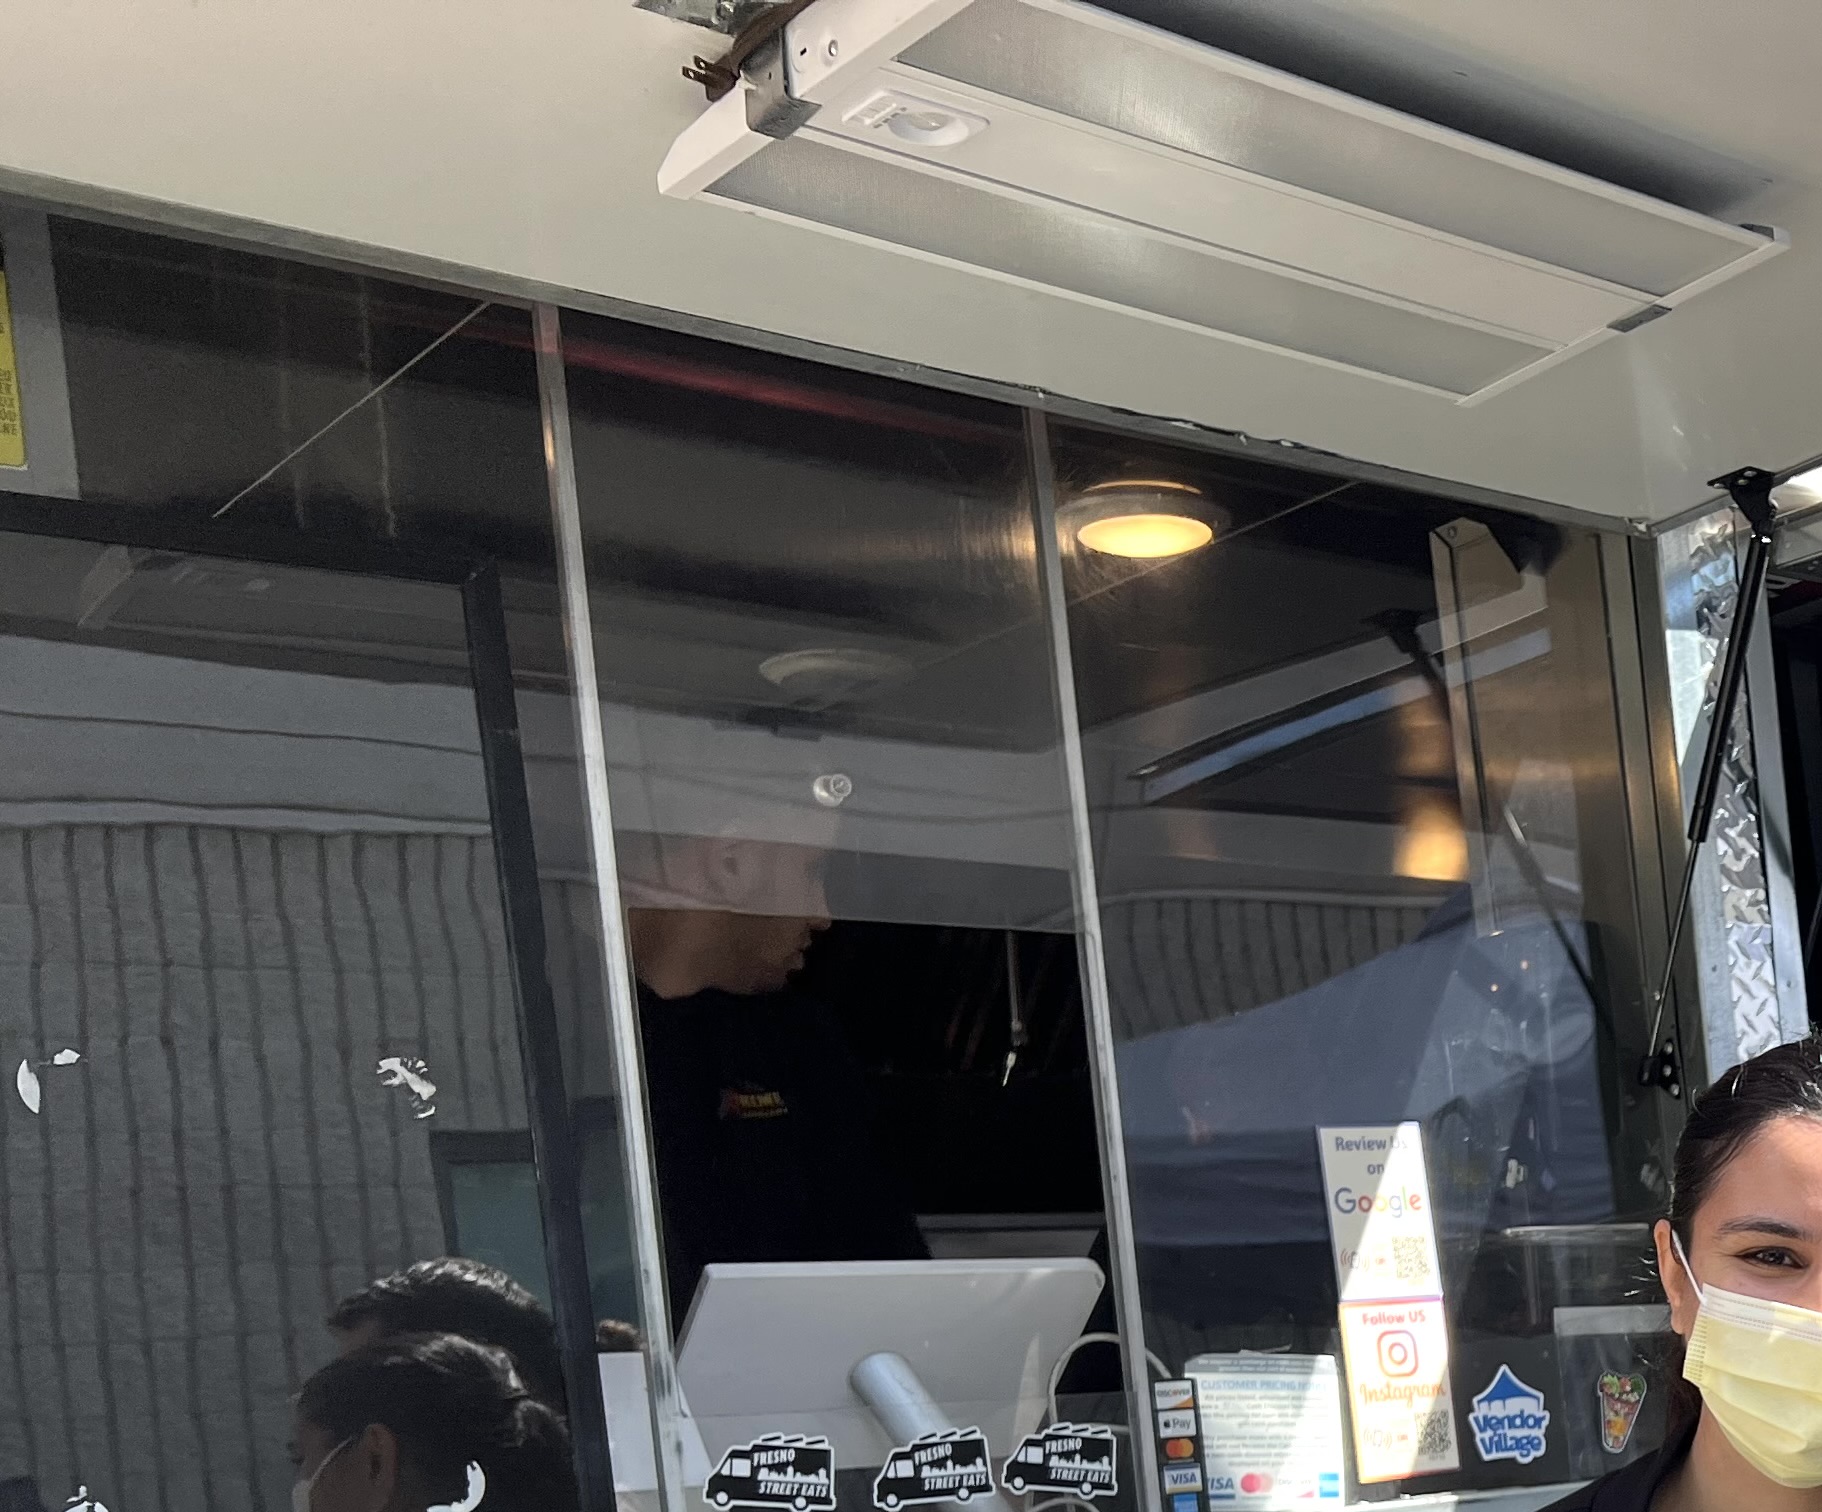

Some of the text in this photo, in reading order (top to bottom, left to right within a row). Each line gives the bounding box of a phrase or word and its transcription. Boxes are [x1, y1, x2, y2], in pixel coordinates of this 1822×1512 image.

[1335, 1136, 1387, 1151] Review
[1334, 1186, 1422, 1219] Google
[1362, 1311, 1405, 1326] Follow
[1200, 1380, 1259, 1391] CUSTOMER
[1260, 1380, 1296, 1391] PRICING
[1359, 1380, 1447, 1408] Instagram
[1172, 1418, 1191, 1430] Pay
[1473, 1409, 1547, 1434] Vendor
[1045, 1437, 1082, 1454] FRESNO
[1479, 1430, 1543, 1458] Village
[753, 1448, 796, 1467] FRESNO
[914, 1442, 953, 1466] FRESNO
[924, 1473, 987, 1491] STREET EATS
[1050, 1467, 1110, 1484] STREET EATS
[1170, 1473, 1197, 1484] VISA
[758, 1481, 828, 1498] STREET EATS
